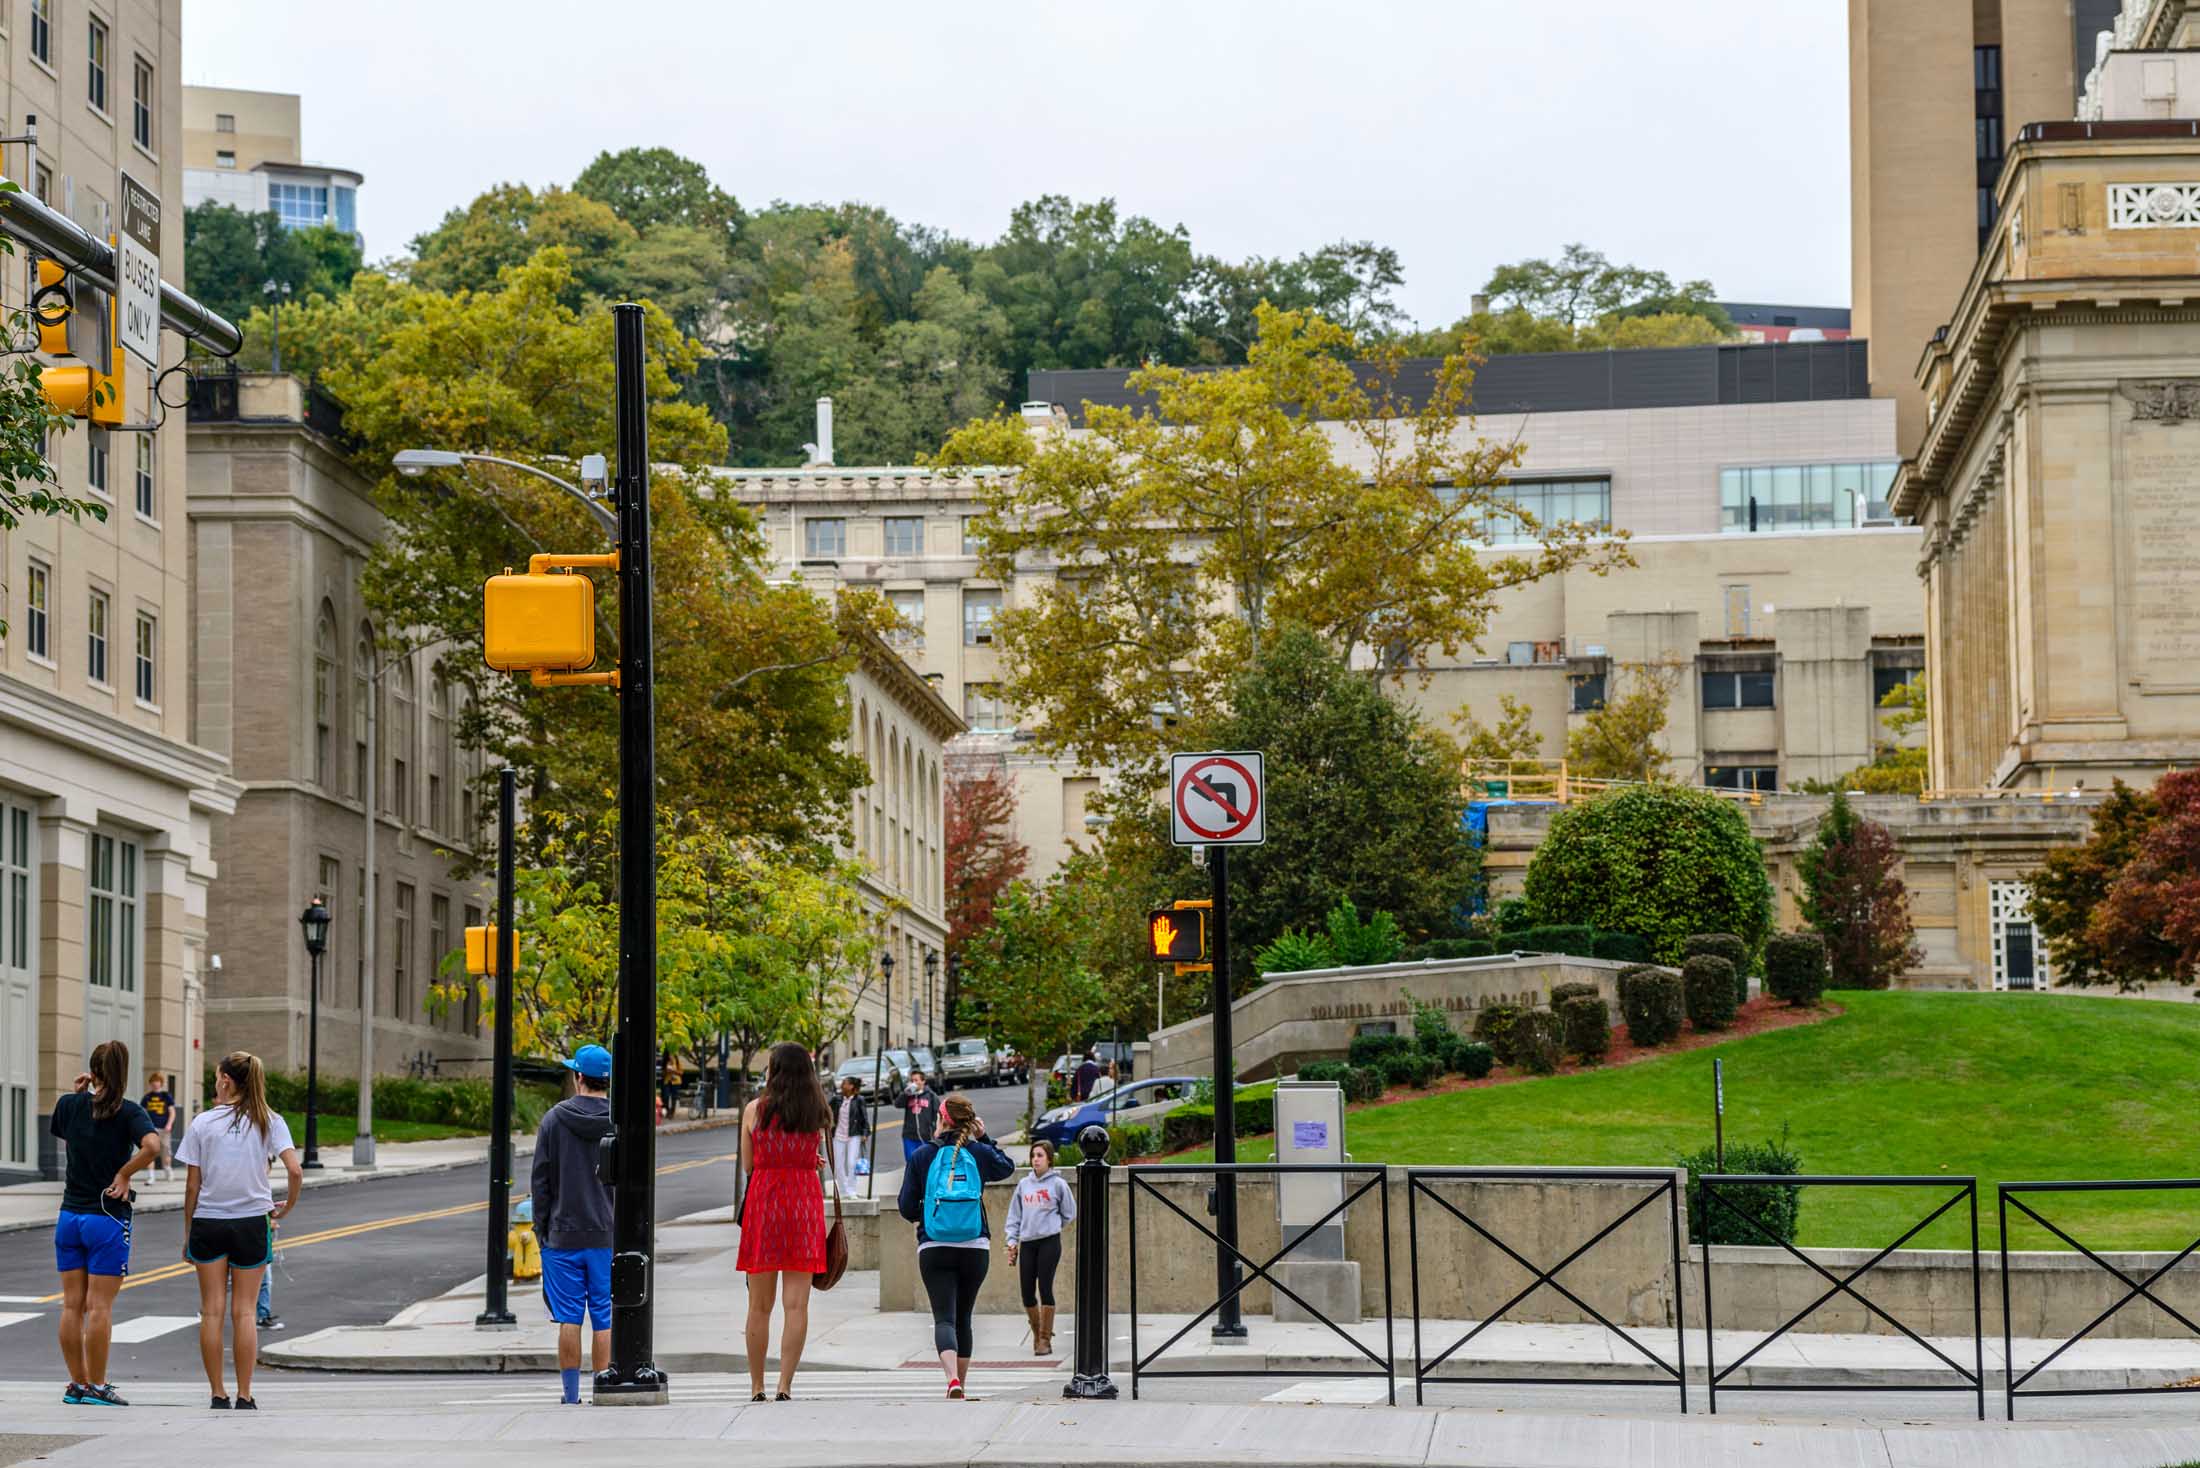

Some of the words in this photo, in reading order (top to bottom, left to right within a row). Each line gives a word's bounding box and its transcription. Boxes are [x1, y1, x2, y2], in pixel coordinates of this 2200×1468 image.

[130, 187, 160, 224] RESTRICTED
[137, 217, 152, 243] LANE
[125, 248, 155, 299] BUSES
[127, 301, 151, 345] ONLY
[1311, 1002, 1373, 1020] SOLDIERS
[1381, 999, 1408, 1016] AND
[1414, 995, 1473, 1011] AILORS
